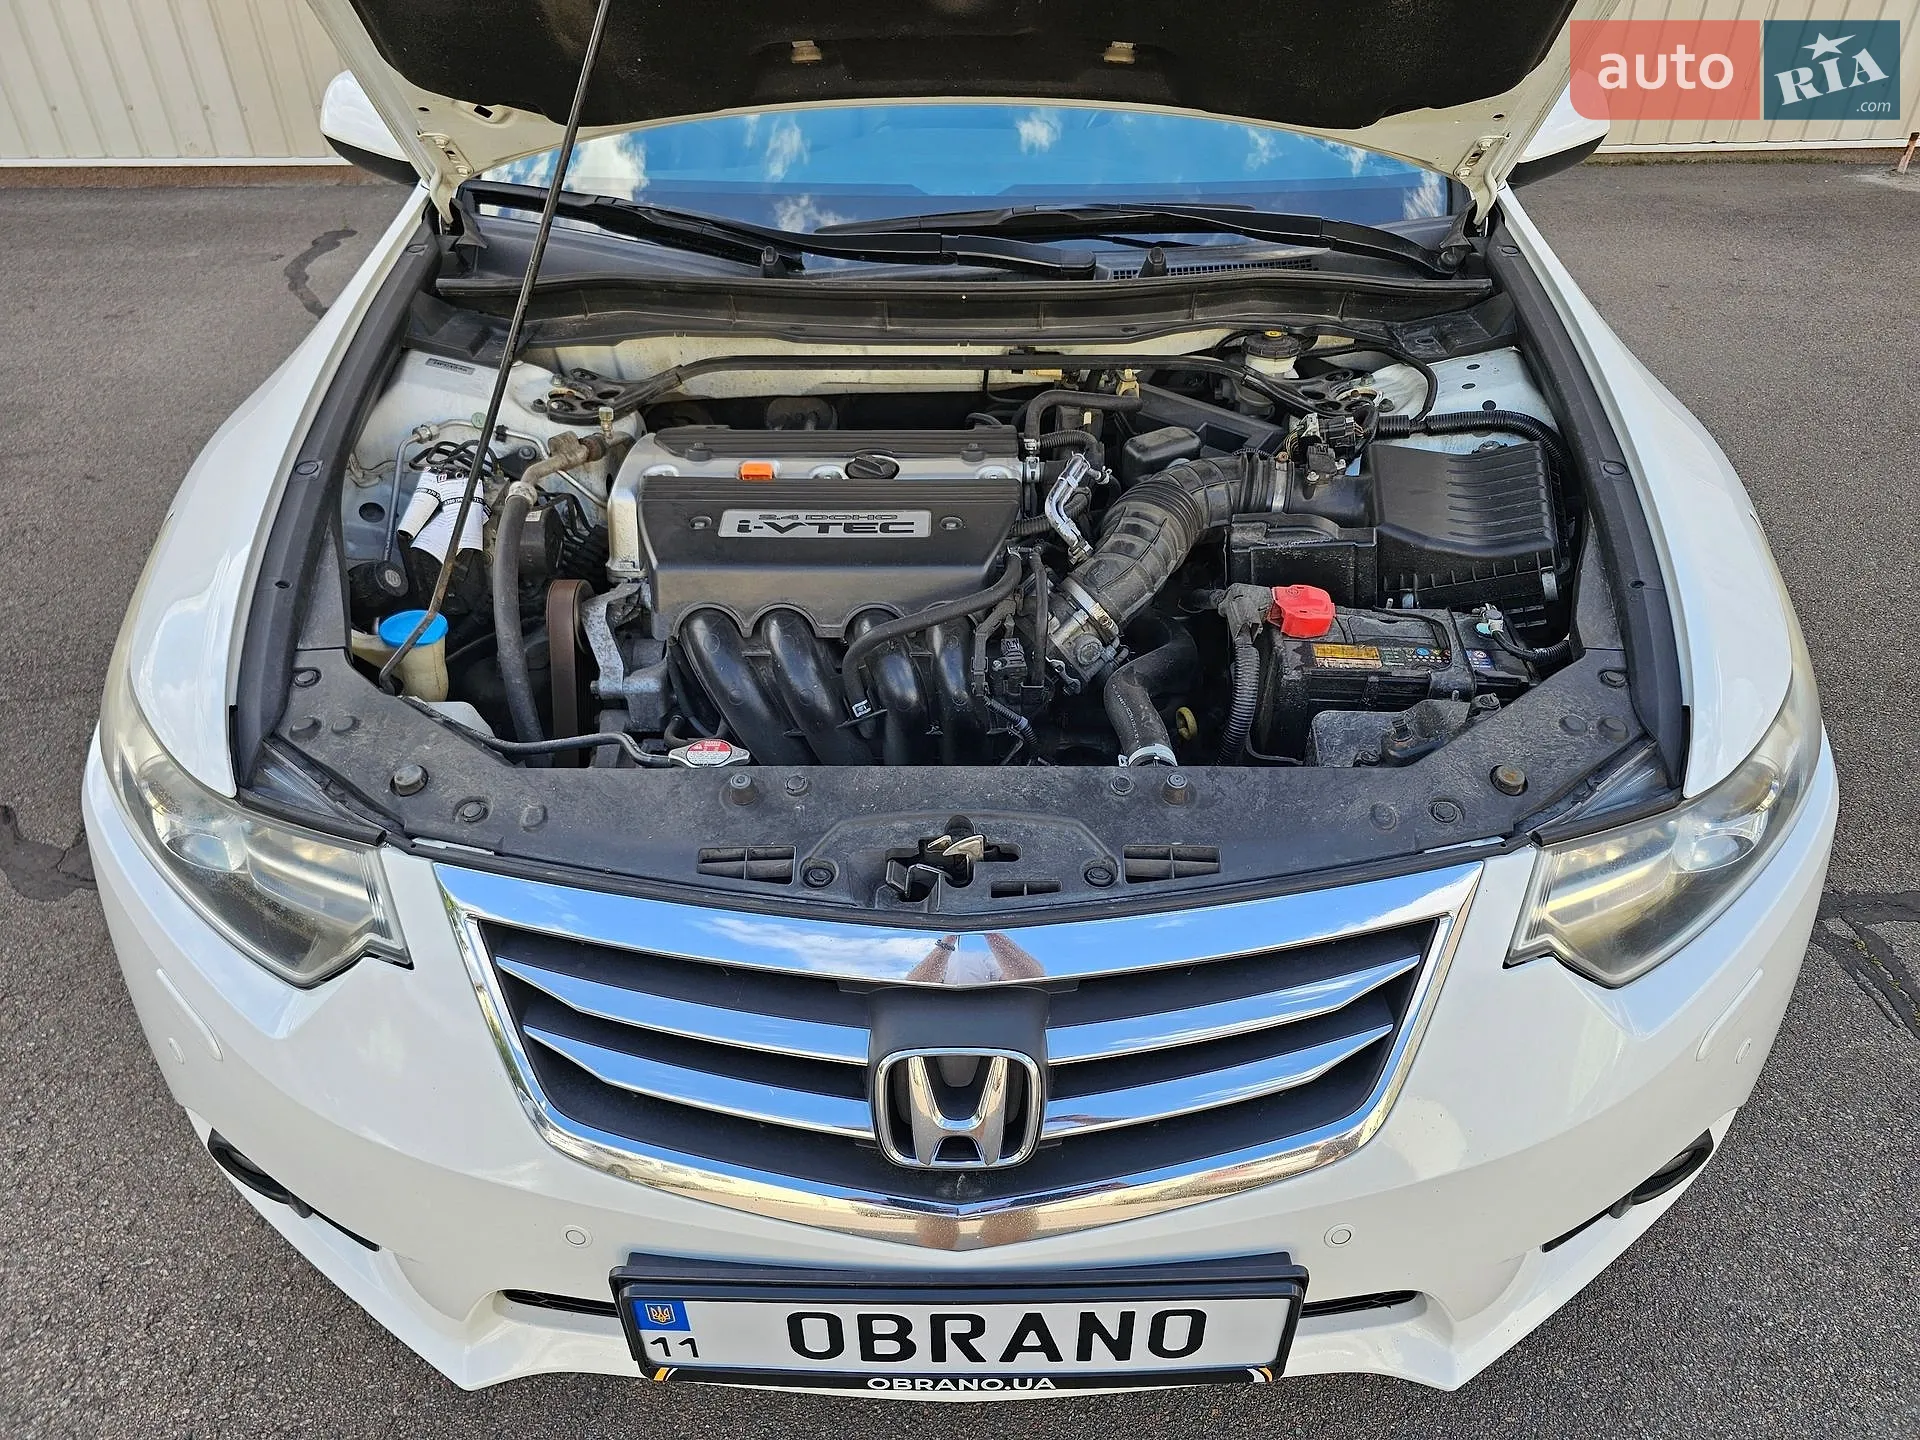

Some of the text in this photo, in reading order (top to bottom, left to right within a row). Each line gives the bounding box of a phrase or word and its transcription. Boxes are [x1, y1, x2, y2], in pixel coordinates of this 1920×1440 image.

[736, 519, 915, 534] i-VTEC
[786, 1308, 1207, 1363] OBRANO
[650, 1336, 700, 1358] 11
[866, 1377, 1056, 1391] OBRANO.UA
